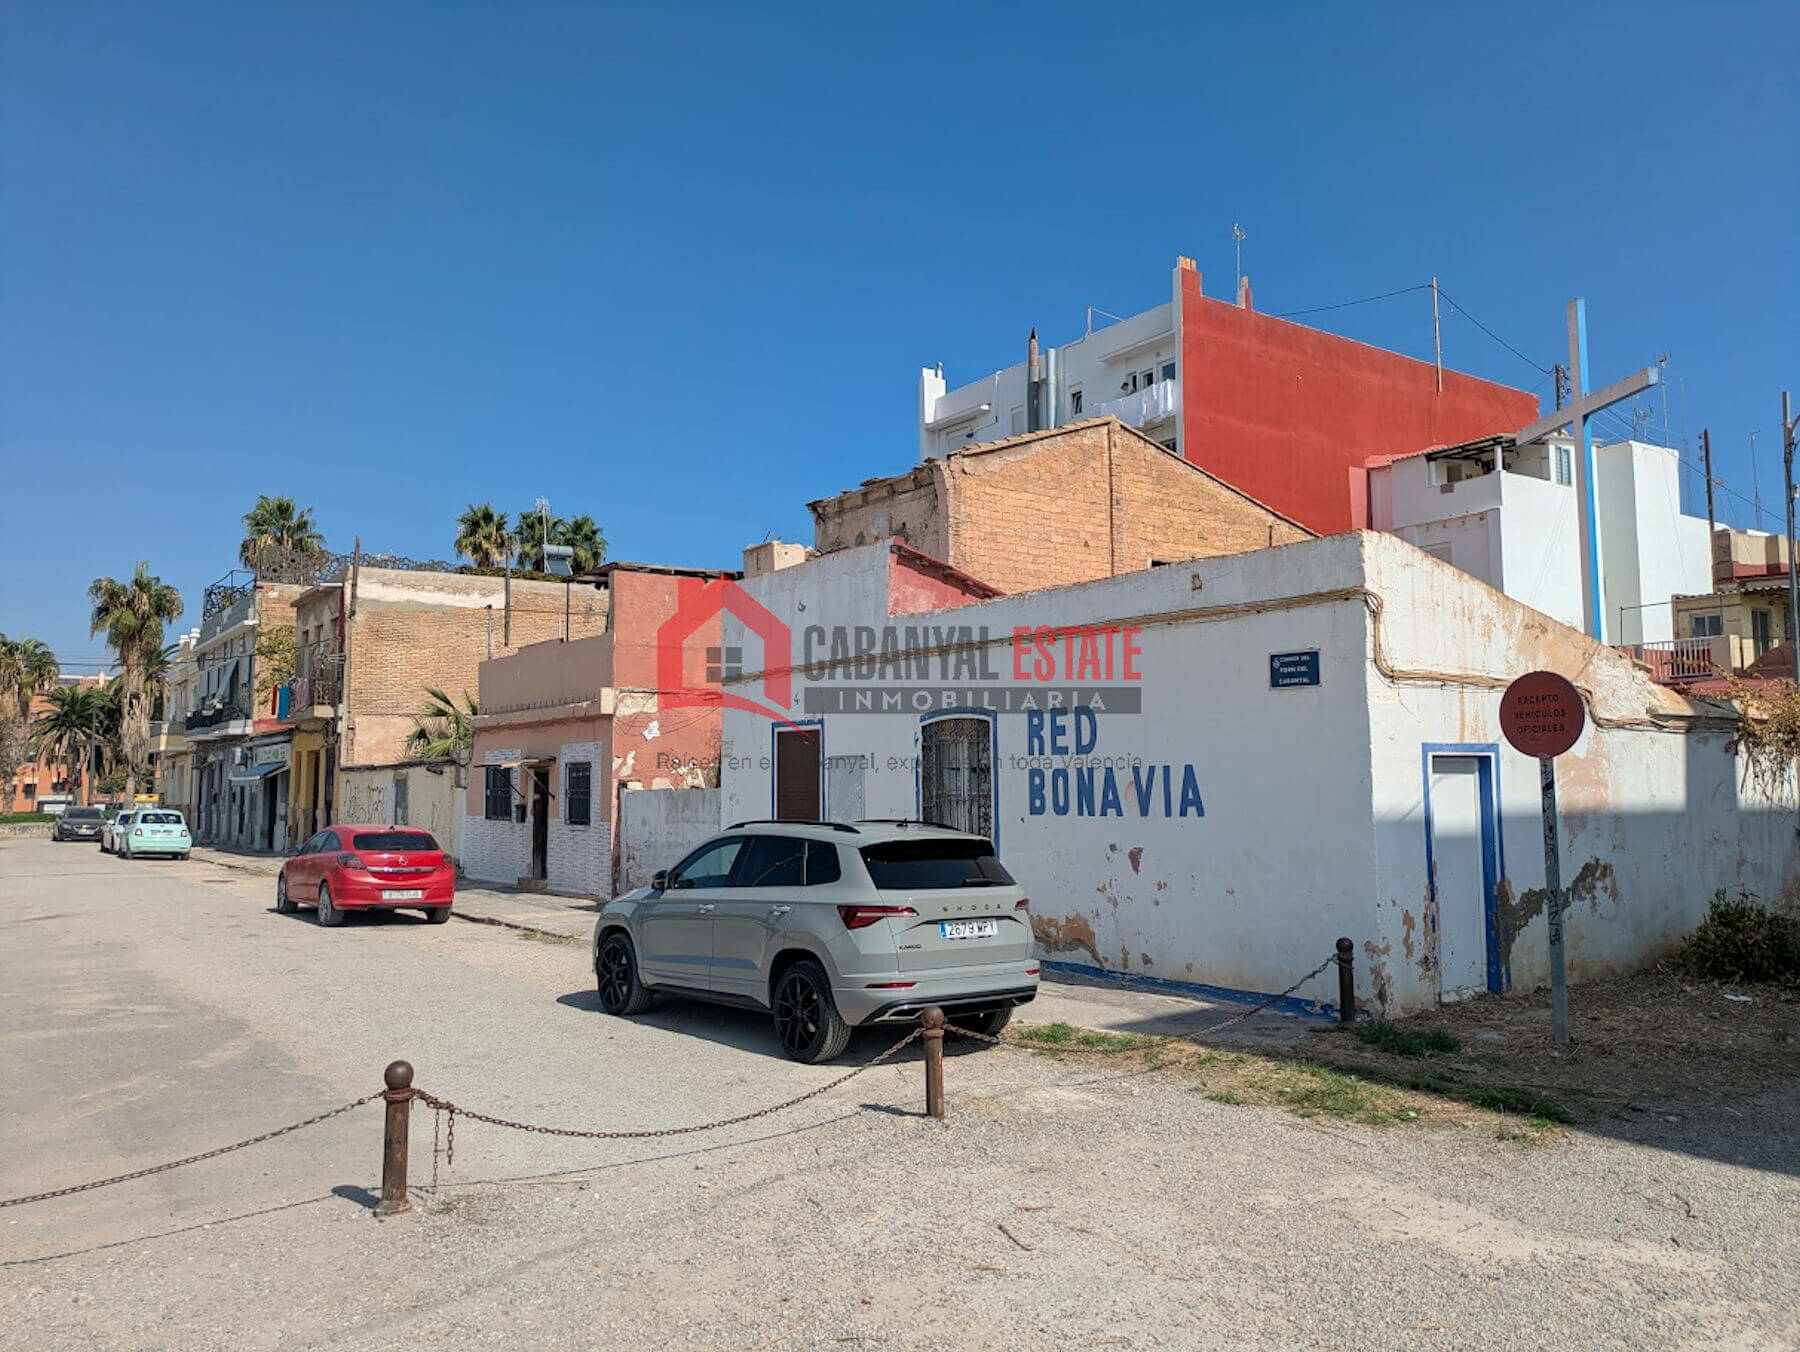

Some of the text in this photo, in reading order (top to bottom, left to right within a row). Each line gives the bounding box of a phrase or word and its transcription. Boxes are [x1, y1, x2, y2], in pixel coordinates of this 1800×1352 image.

[1517, 694, 1560, 705] EXCEPTO
[1027, 705, 1098, 756] RED
[1516, 723, 1565, 735] OFICIALES
[949, 921, 974, 936] 2679
